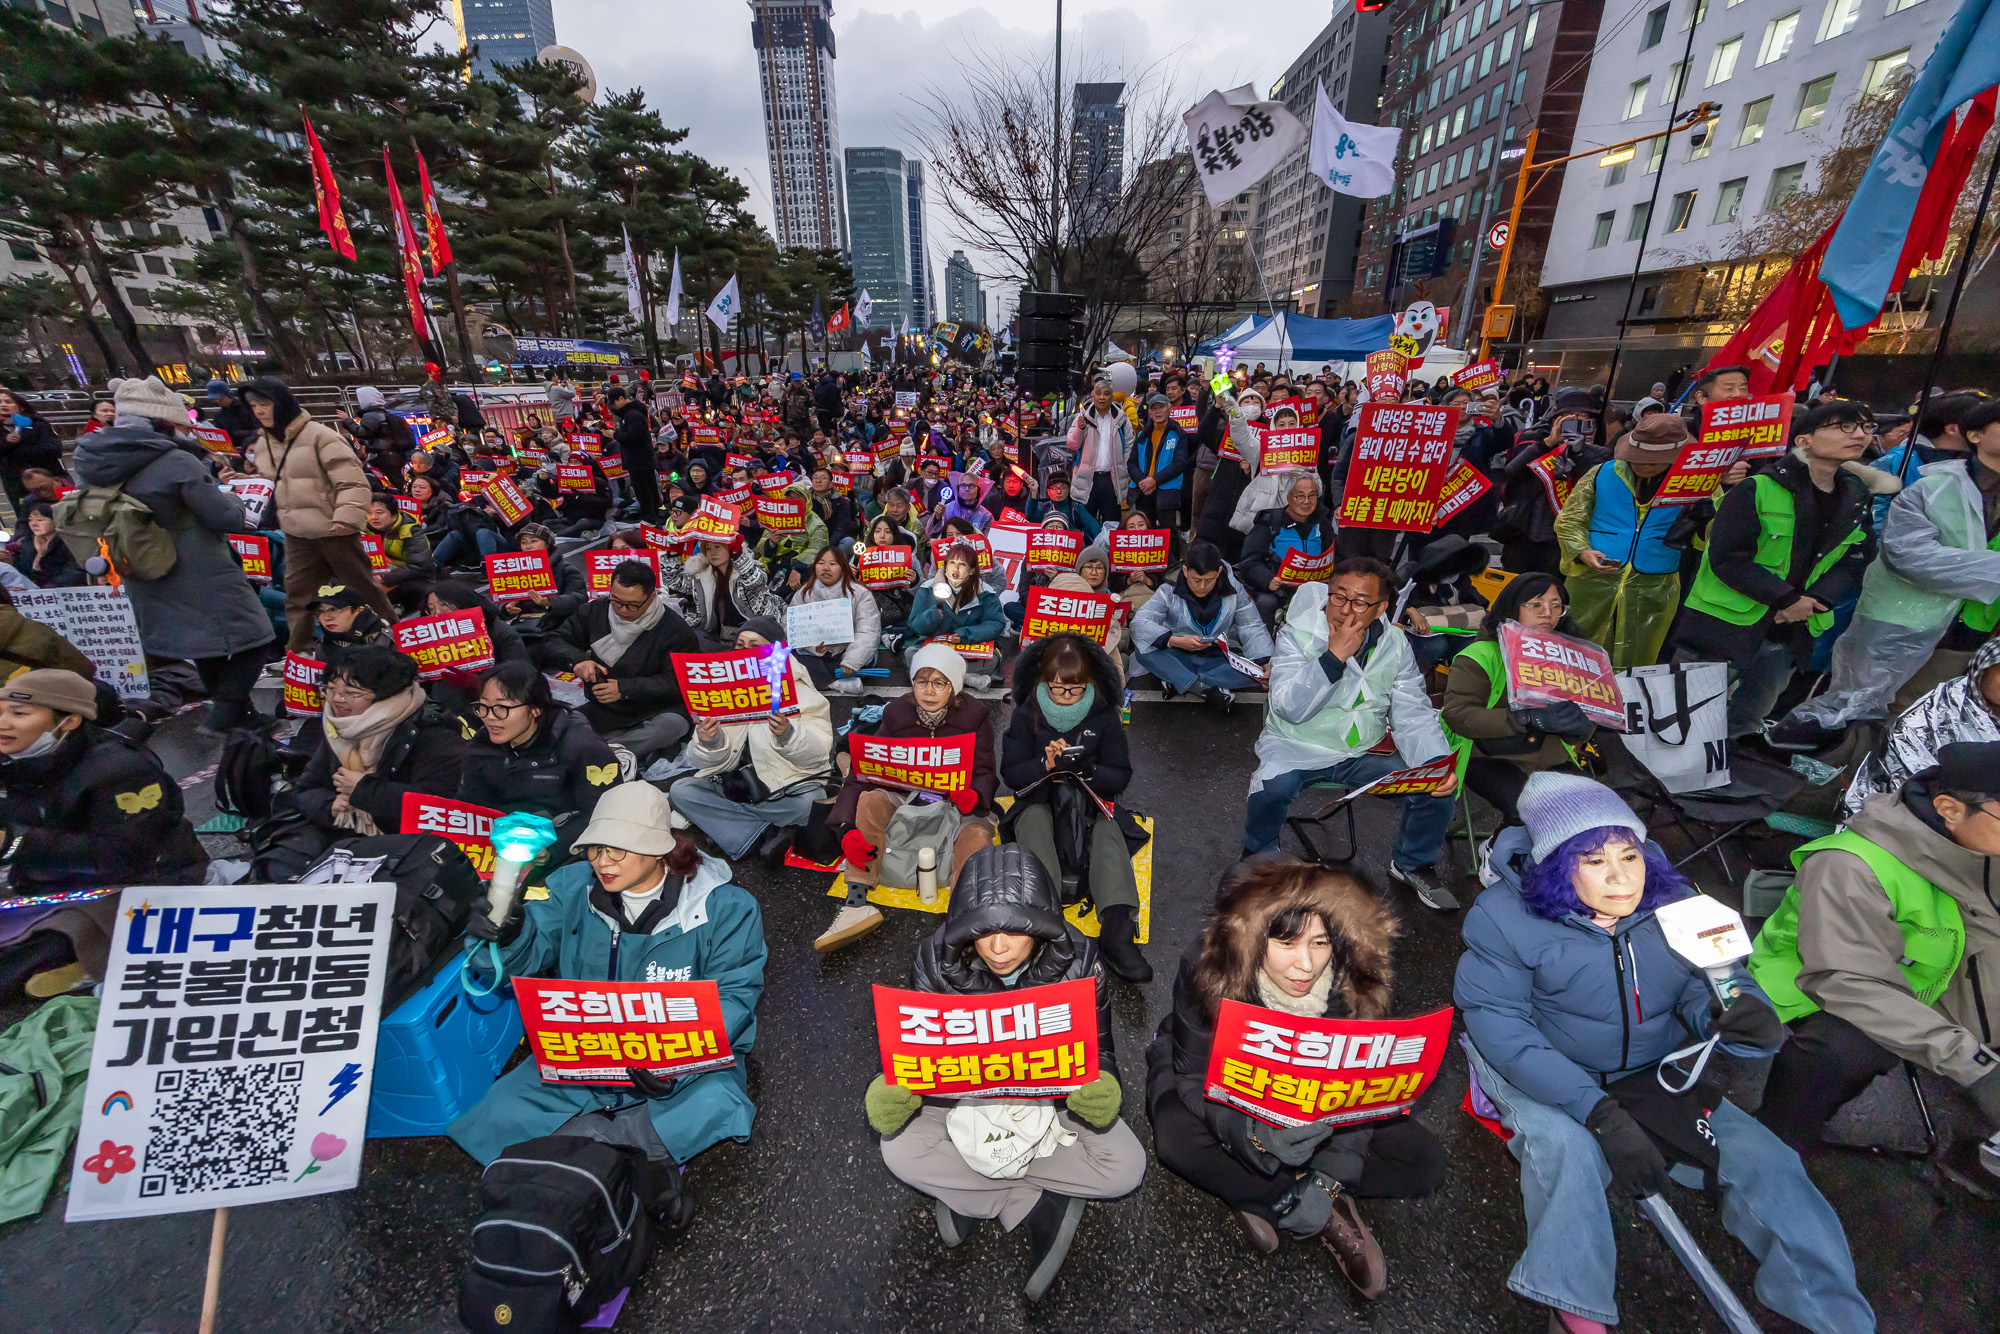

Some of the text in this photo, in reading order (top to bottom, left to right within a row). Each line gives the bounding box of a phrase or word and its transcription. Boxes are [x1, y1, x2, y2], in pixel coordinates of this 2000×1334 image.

[1371, 361, 1402, 375] 사형이다
[1458, 363, 1491, 381] 조희대를
[1370, 373, 1405, 394] 윤석열
[1371, 408, 1447, 436] 내란당은 국민을
[1710, 401, 1781, 426] 조희대를
[571, 434, 598, 443] 조희대를
[1268, 433, 1316, 449] 조희대를
[1358, 436, 1448, 465] 절대 이길 수 없다
[1263, 450, 1317, 467] 탄핵하라!
[559, 478, 592, 488] 탄핵하라!
[560, 467, 588, 478] 조희대를
[760, 476, 788, 488] 조희대를
[1362, 465, 1430, 495] 내란당이
[487, 481, 521, 521] 탄핵하라!
[497, 476, 528, 512] 조희대를
[756, 499, 798, 514] 조희대를
[758, 512, 802, 528] 탄핵하라!
[1343, 495, 1435, 525] 퇴출 될 때까지!
[1032, 533, 1077, 549] 조희대를
[1115, 534, 1164, 549] 조희대를
[492, 557, 543, 573] 조희대를
[862, 549, 906, 566] 조희대를
[1028, 549, 1077, 566] 탄핵하라!
[1112, 550, 1166, 565] 탄핵하라!
[491, 572, 551, 593] 탄핵하라!
[1036, 594, 1107, 620] 조희대를
[398, 618, 476, 649] 조희대를
[1520, 634, 1603, 677] 조희대를
[1517, 661, 1618, 707] 탄핵하라!
[863, 741, 962, 768] 조희대를
[858, 760, 967, 793] 탄핵하라!
[126, 902, 379, 955] 대구청년
[118, 953, 371, 1010] 촛불행동
[537, 989, 700, 1024] 조희대를
[105, 1004, 365, 1068] 가입신청
[898, 1002, 1073, 1046] 조희대를
[536, 1028, 720, 1063] 탄핵하라!
[1240, 1020, 1428, 1070] 조희대를
[891, 1040, 1087, 1091] 탄핵하라!
[1222, 1056, 1425, 1114] 탄핵하라!
